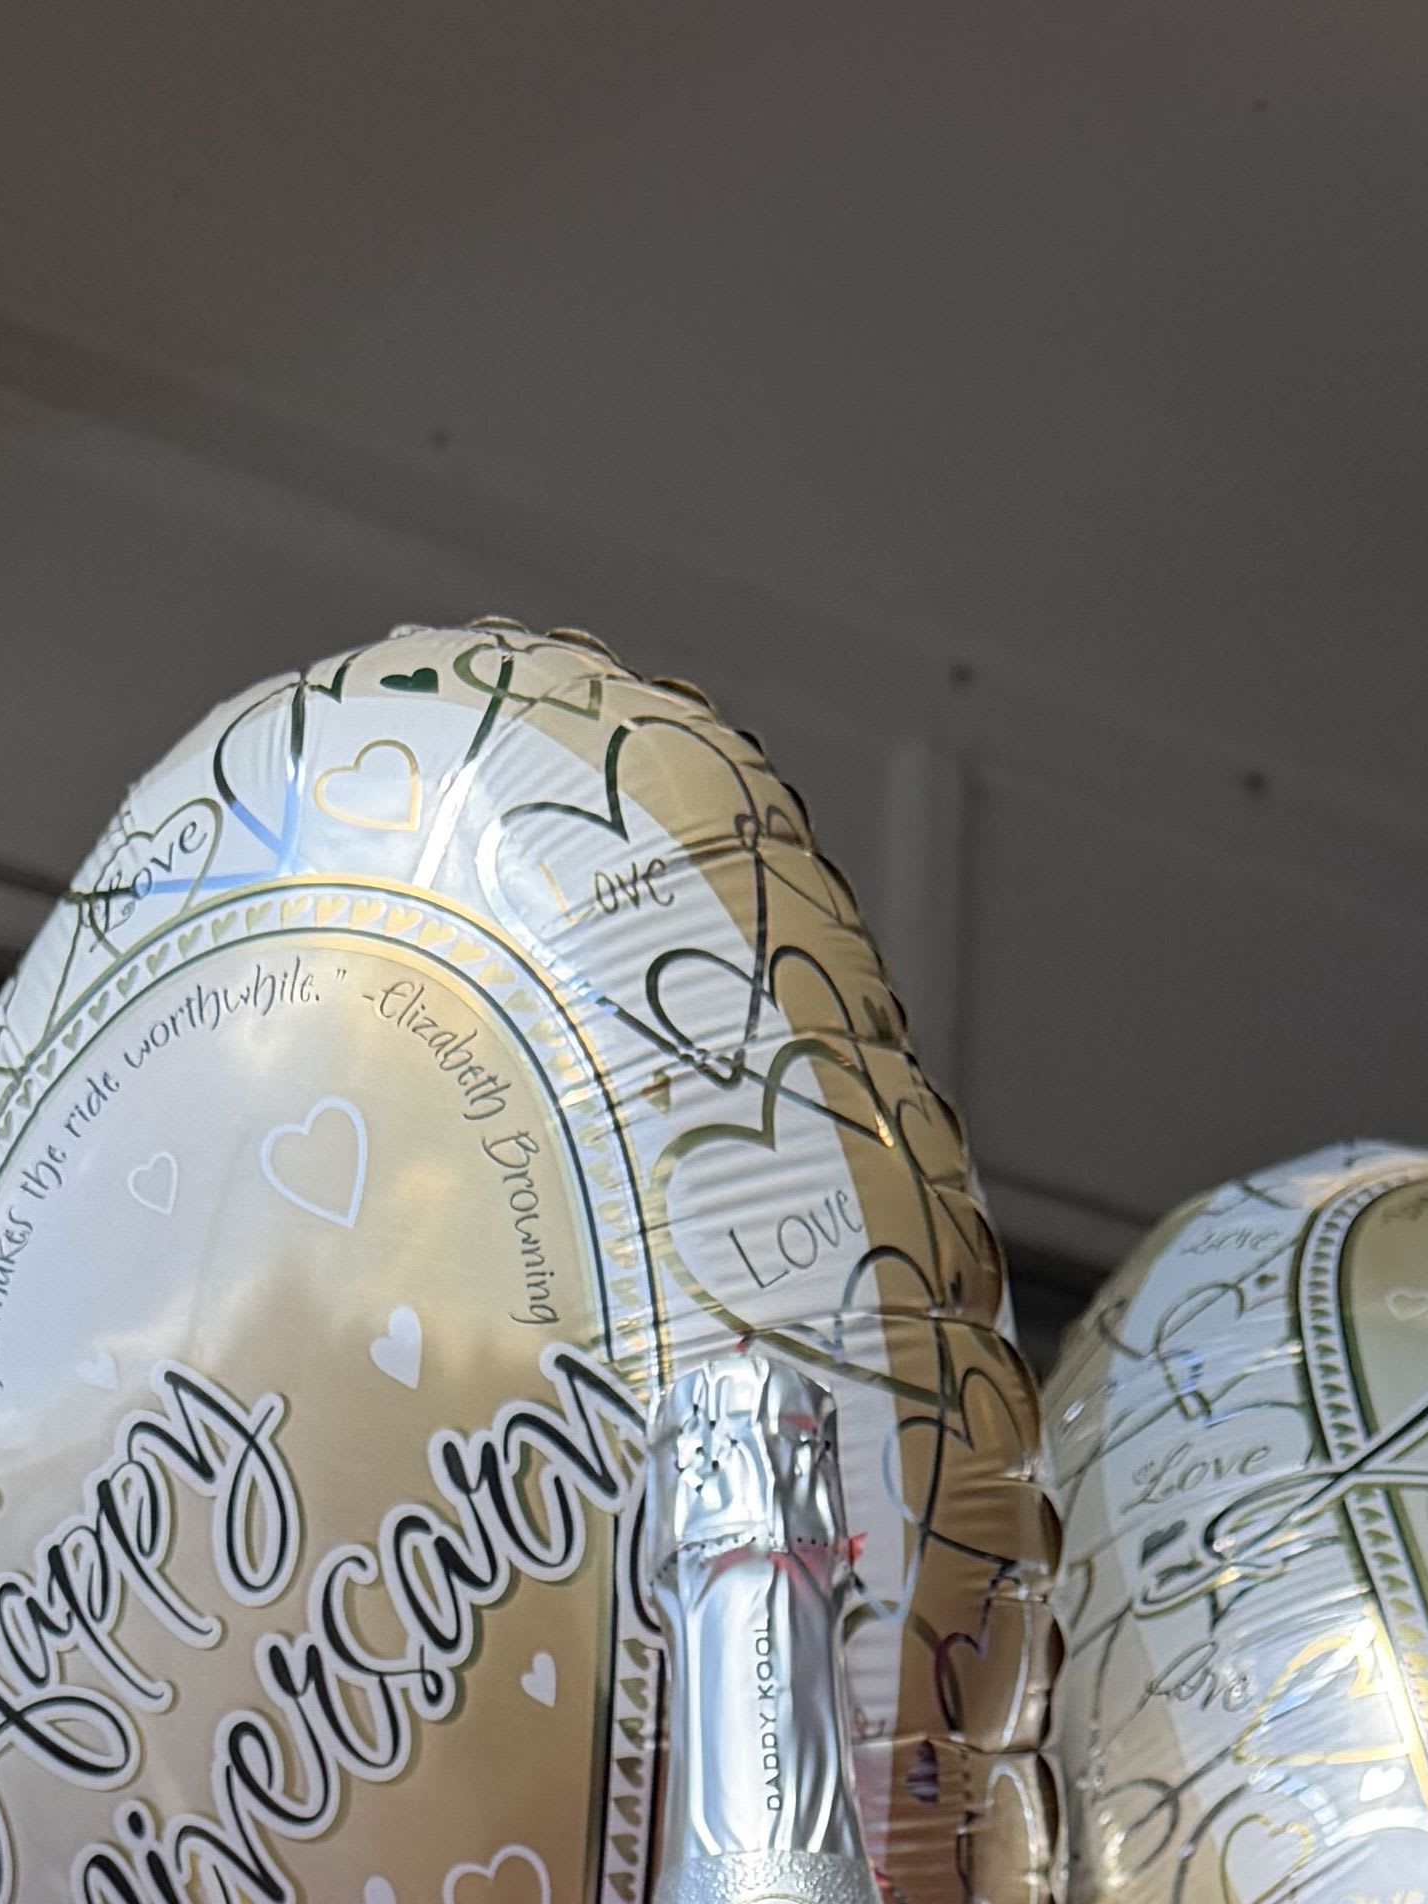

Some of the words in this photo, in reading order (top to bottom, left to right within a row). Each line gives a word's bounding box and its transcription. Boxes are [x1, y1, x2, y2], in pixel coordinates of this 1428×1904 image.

[19, 1143, 68, 1201] the
[63, 1070, 121, 1139] ride
[481, 1128, 561, 1327] Browning
[753, 1617, 776, 1700] KOOL
[762, 1714, 784, 1812] DADDY
